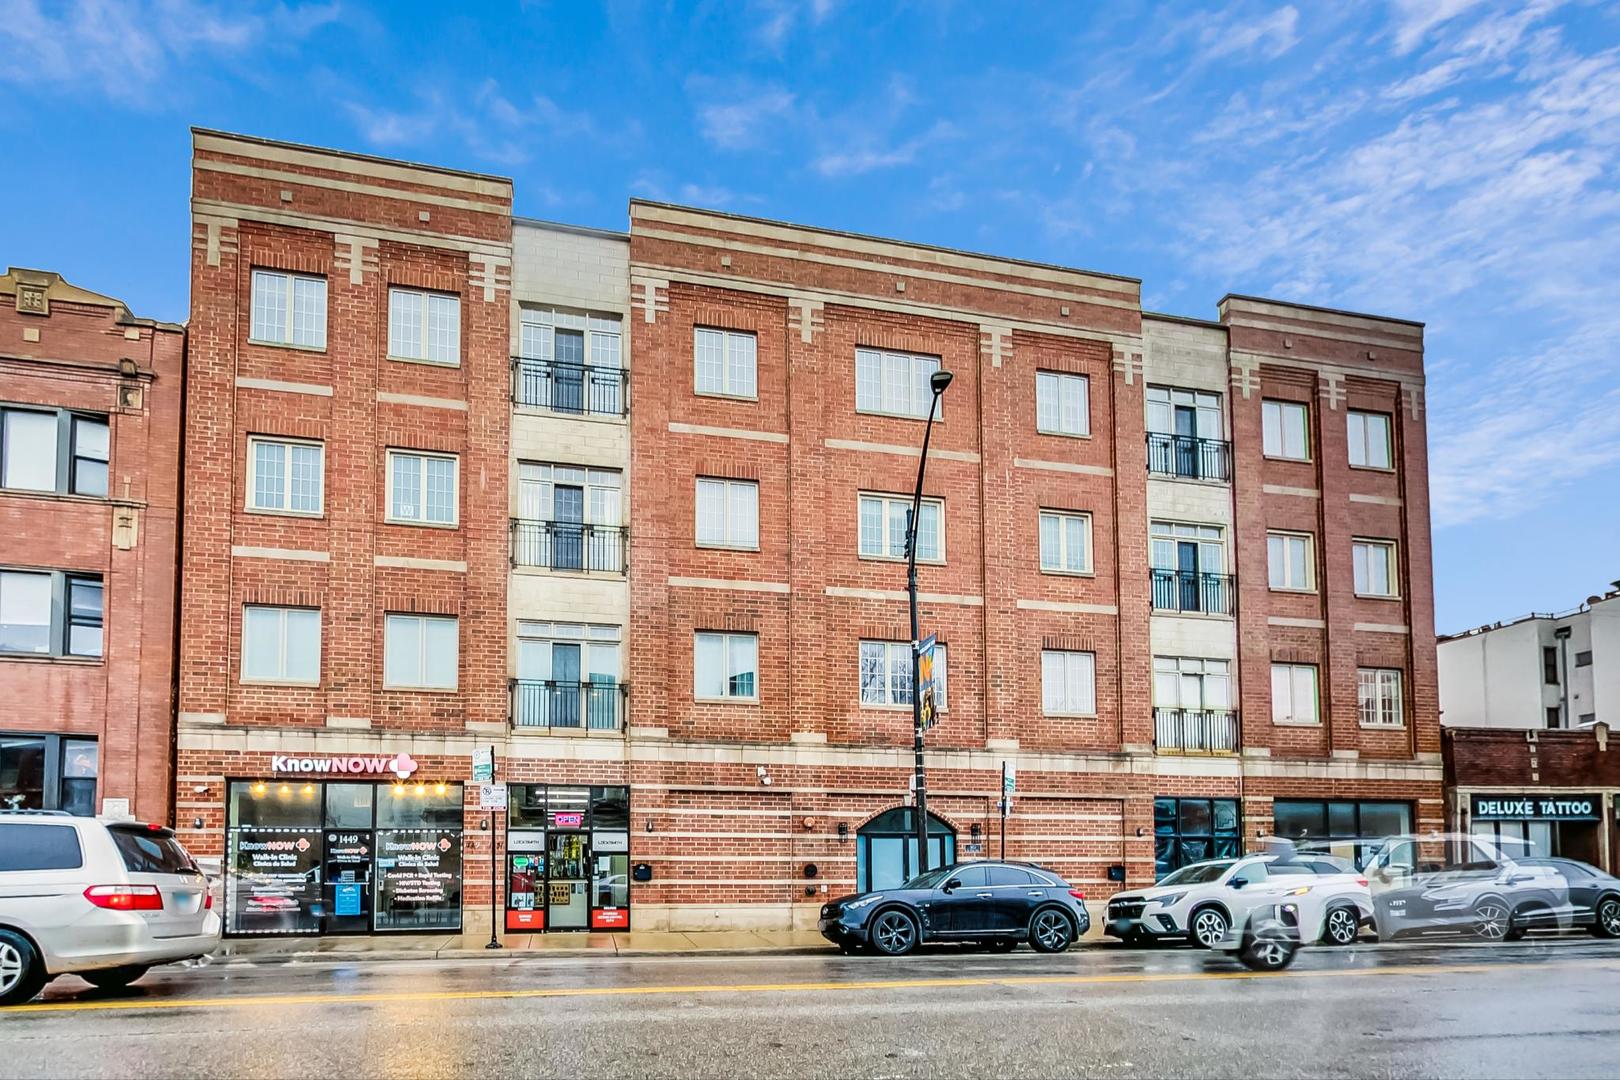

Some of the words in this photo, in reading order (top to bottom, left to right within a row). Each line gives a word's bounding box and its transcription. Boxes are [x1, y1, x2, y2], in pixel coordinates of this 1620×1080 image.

[272, 755, 387, 773] KnowNOW
[1478, 801, 1534, 815] DELUXE
[1539, 801, 1592, 815] TATTOO
[557, 815, 579, 824] OPEN
[339, 834, 358, 844] 1449
[240, 841, 295, 850] KnowNOW
[385, 842, 437, 851] KnowNOW
